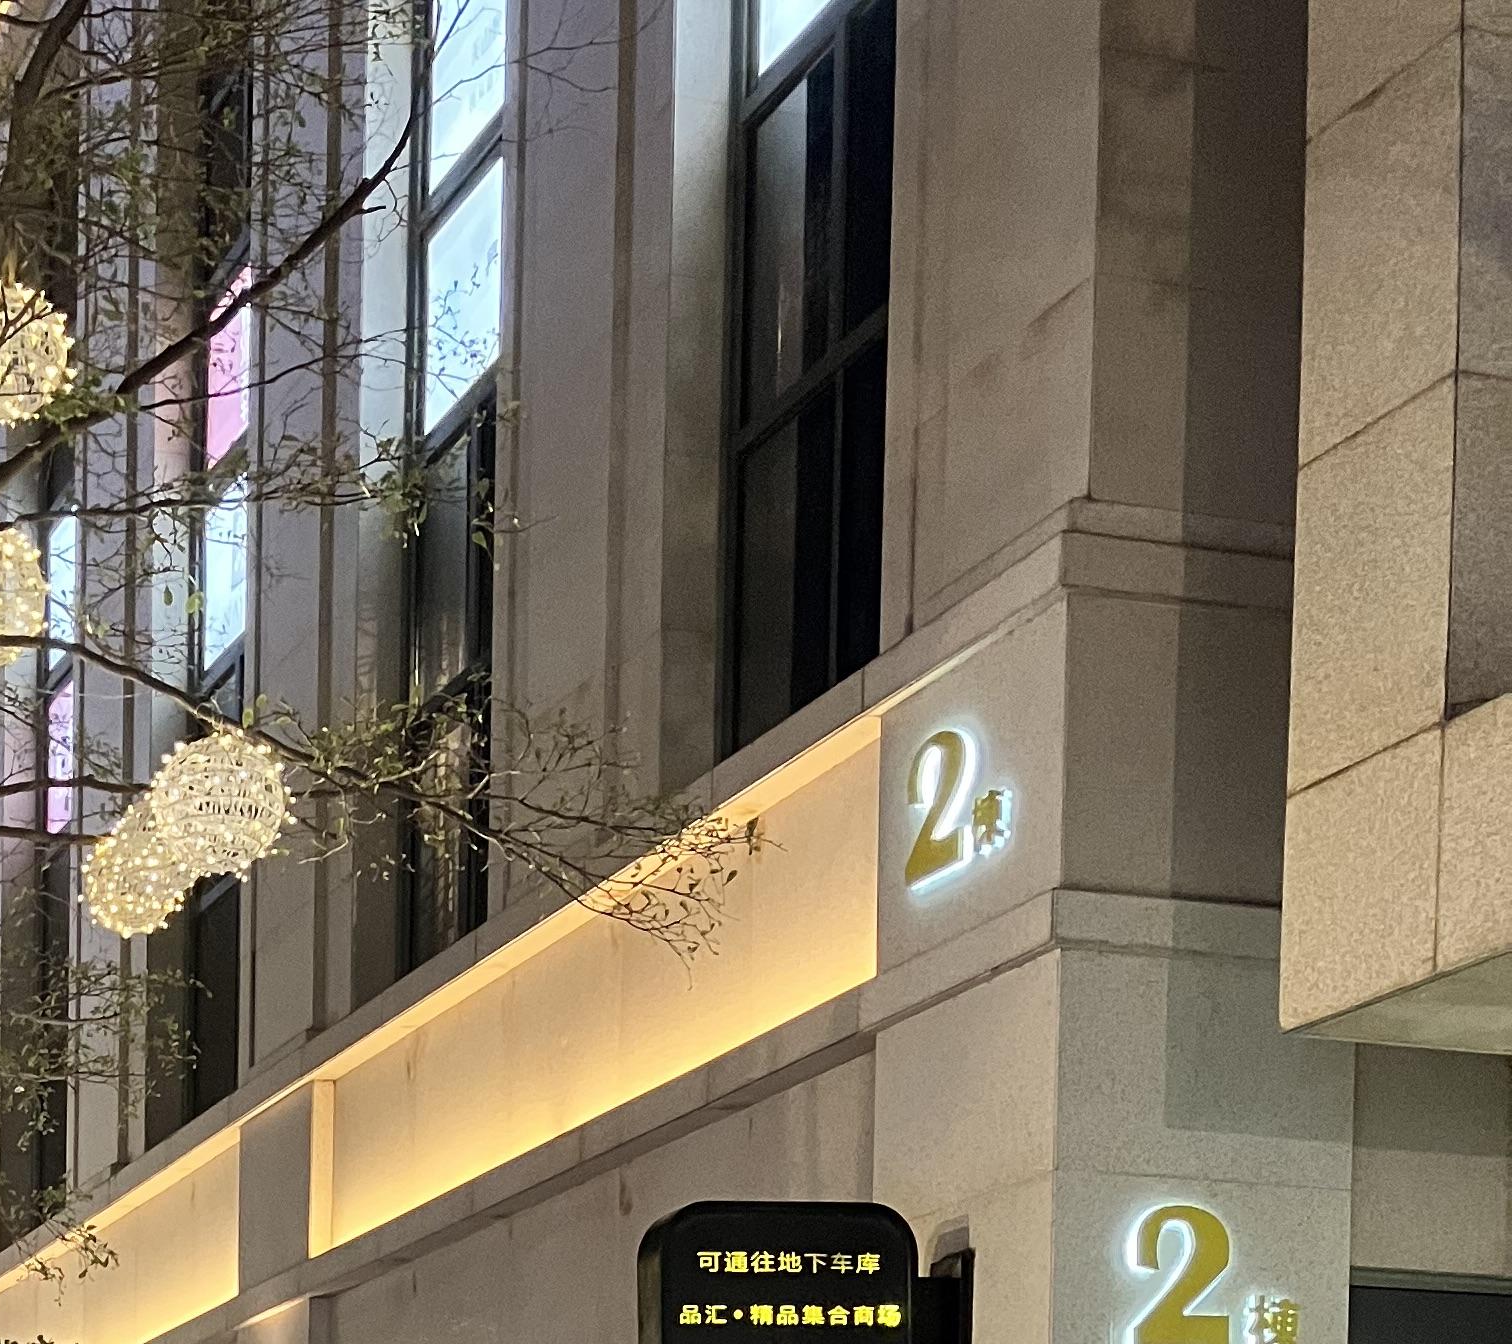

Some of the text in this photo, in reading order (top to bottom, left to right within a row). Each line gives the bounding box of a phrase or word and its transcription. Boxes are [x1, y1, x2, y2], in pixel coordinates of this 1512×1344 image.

[696, 1250, 882, 1275] 可通往地下车库
